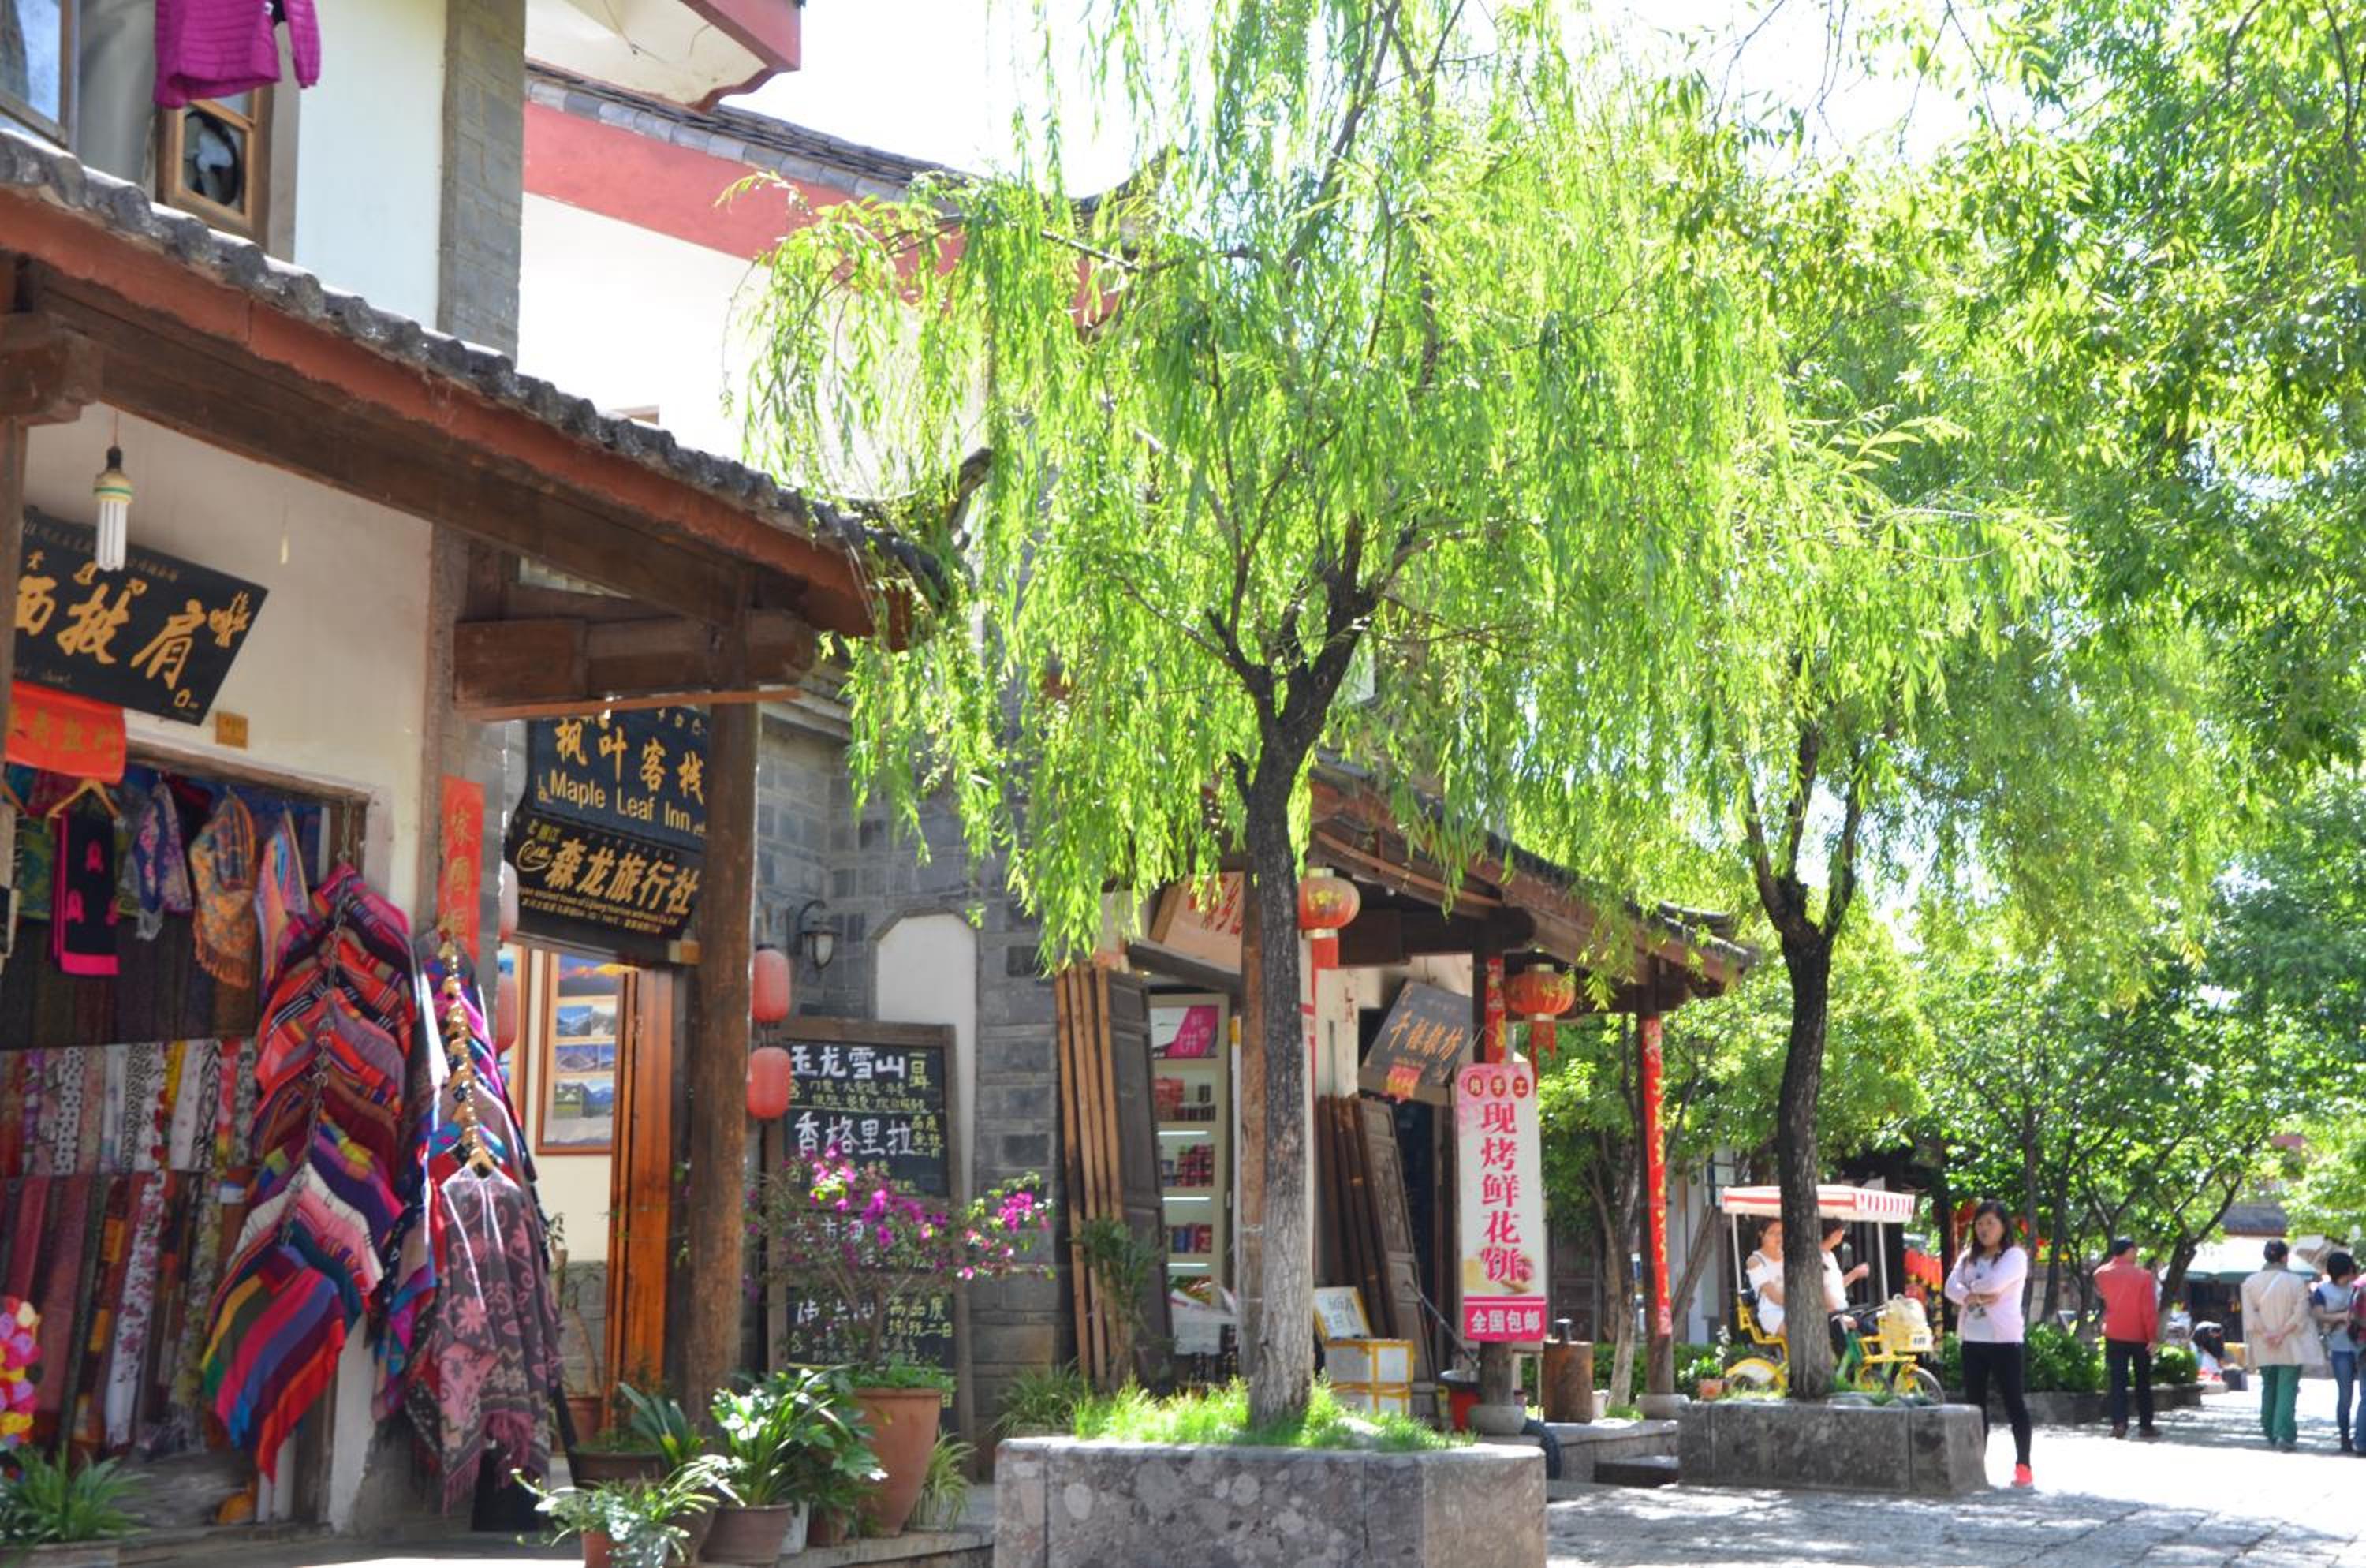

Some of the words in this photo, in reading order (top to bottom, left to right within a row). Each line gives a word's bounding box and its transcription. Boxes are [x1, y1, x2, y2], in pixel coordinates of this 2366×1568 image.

[554, 718, 705, 805] 枫叶客栈
[550, 769, 606, 810] Maple
[616, 786, 655, 822] Leaf
[665, 806, 690, 830] Inn
[790, 1045, 905, 1080] 玉龙雪山
[795, 1111, 915, 1158] 香格里拉
[1480, 1101, 1521, 1283] 现烤鲜花饼
[1470, 1308, 1541, 1335] 全国包邮
